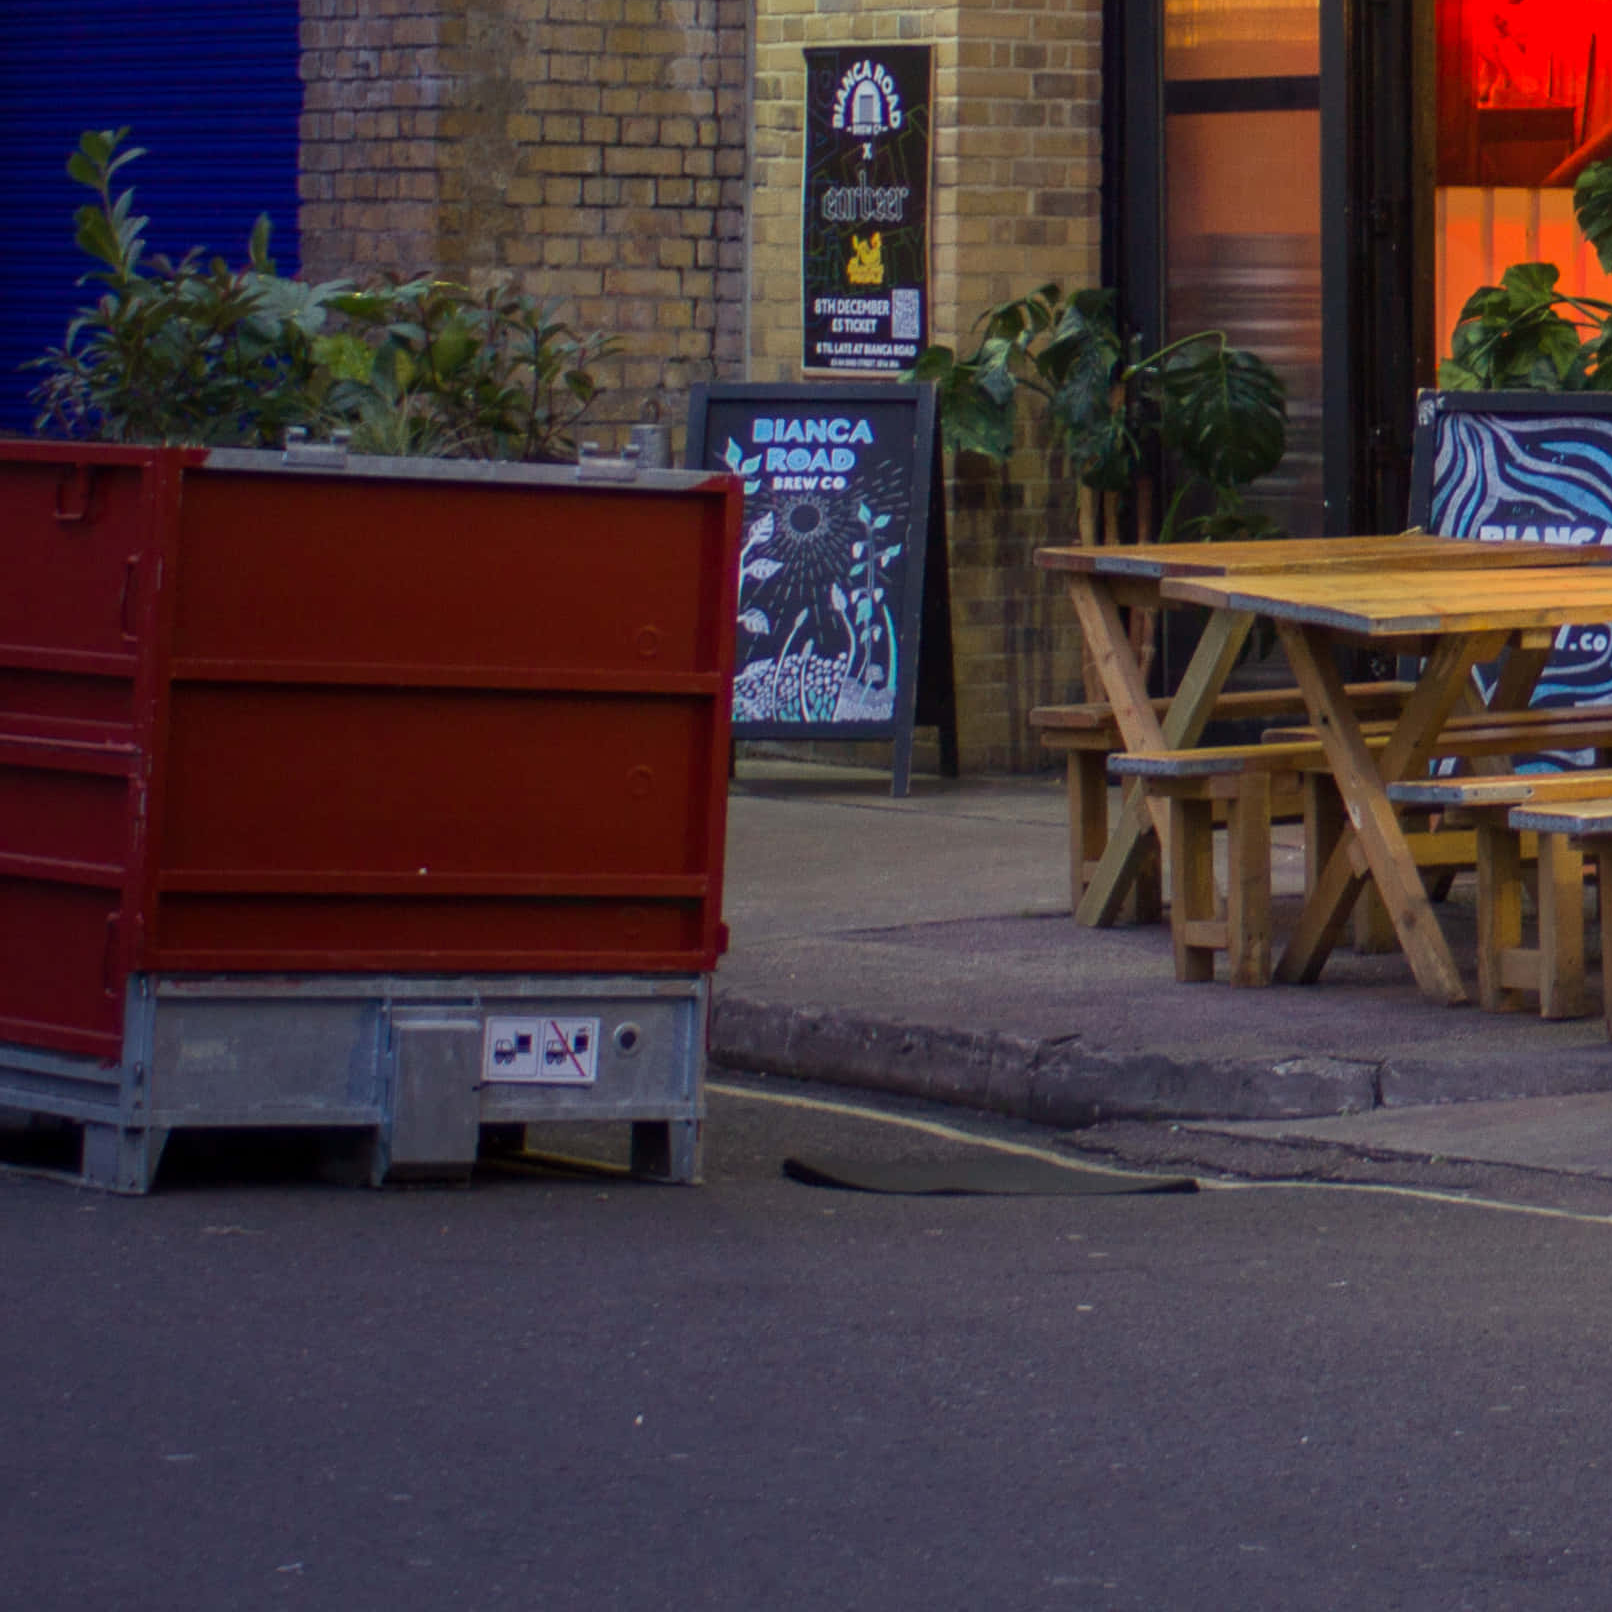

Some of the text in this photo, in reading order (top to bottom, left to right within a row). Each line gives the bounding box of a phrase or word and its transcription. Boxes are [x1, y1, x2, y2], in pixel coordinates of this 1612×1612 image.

[832, 60, 902, 129] BIANCA ROAD
[823, 169, 910, 222] earbeer
[814, 297, 891, 317] 8TH DECEMBER
[845, 317, 879, 334] TICKET
[864, 342, 892, 357] BIANCA
[893, 343, 917, 357] ROAD
[752, 418, 874, 444] BIANCA
[765, 447, 856, 473] ROAD
[772, 475, 847, 491] BREW CO
